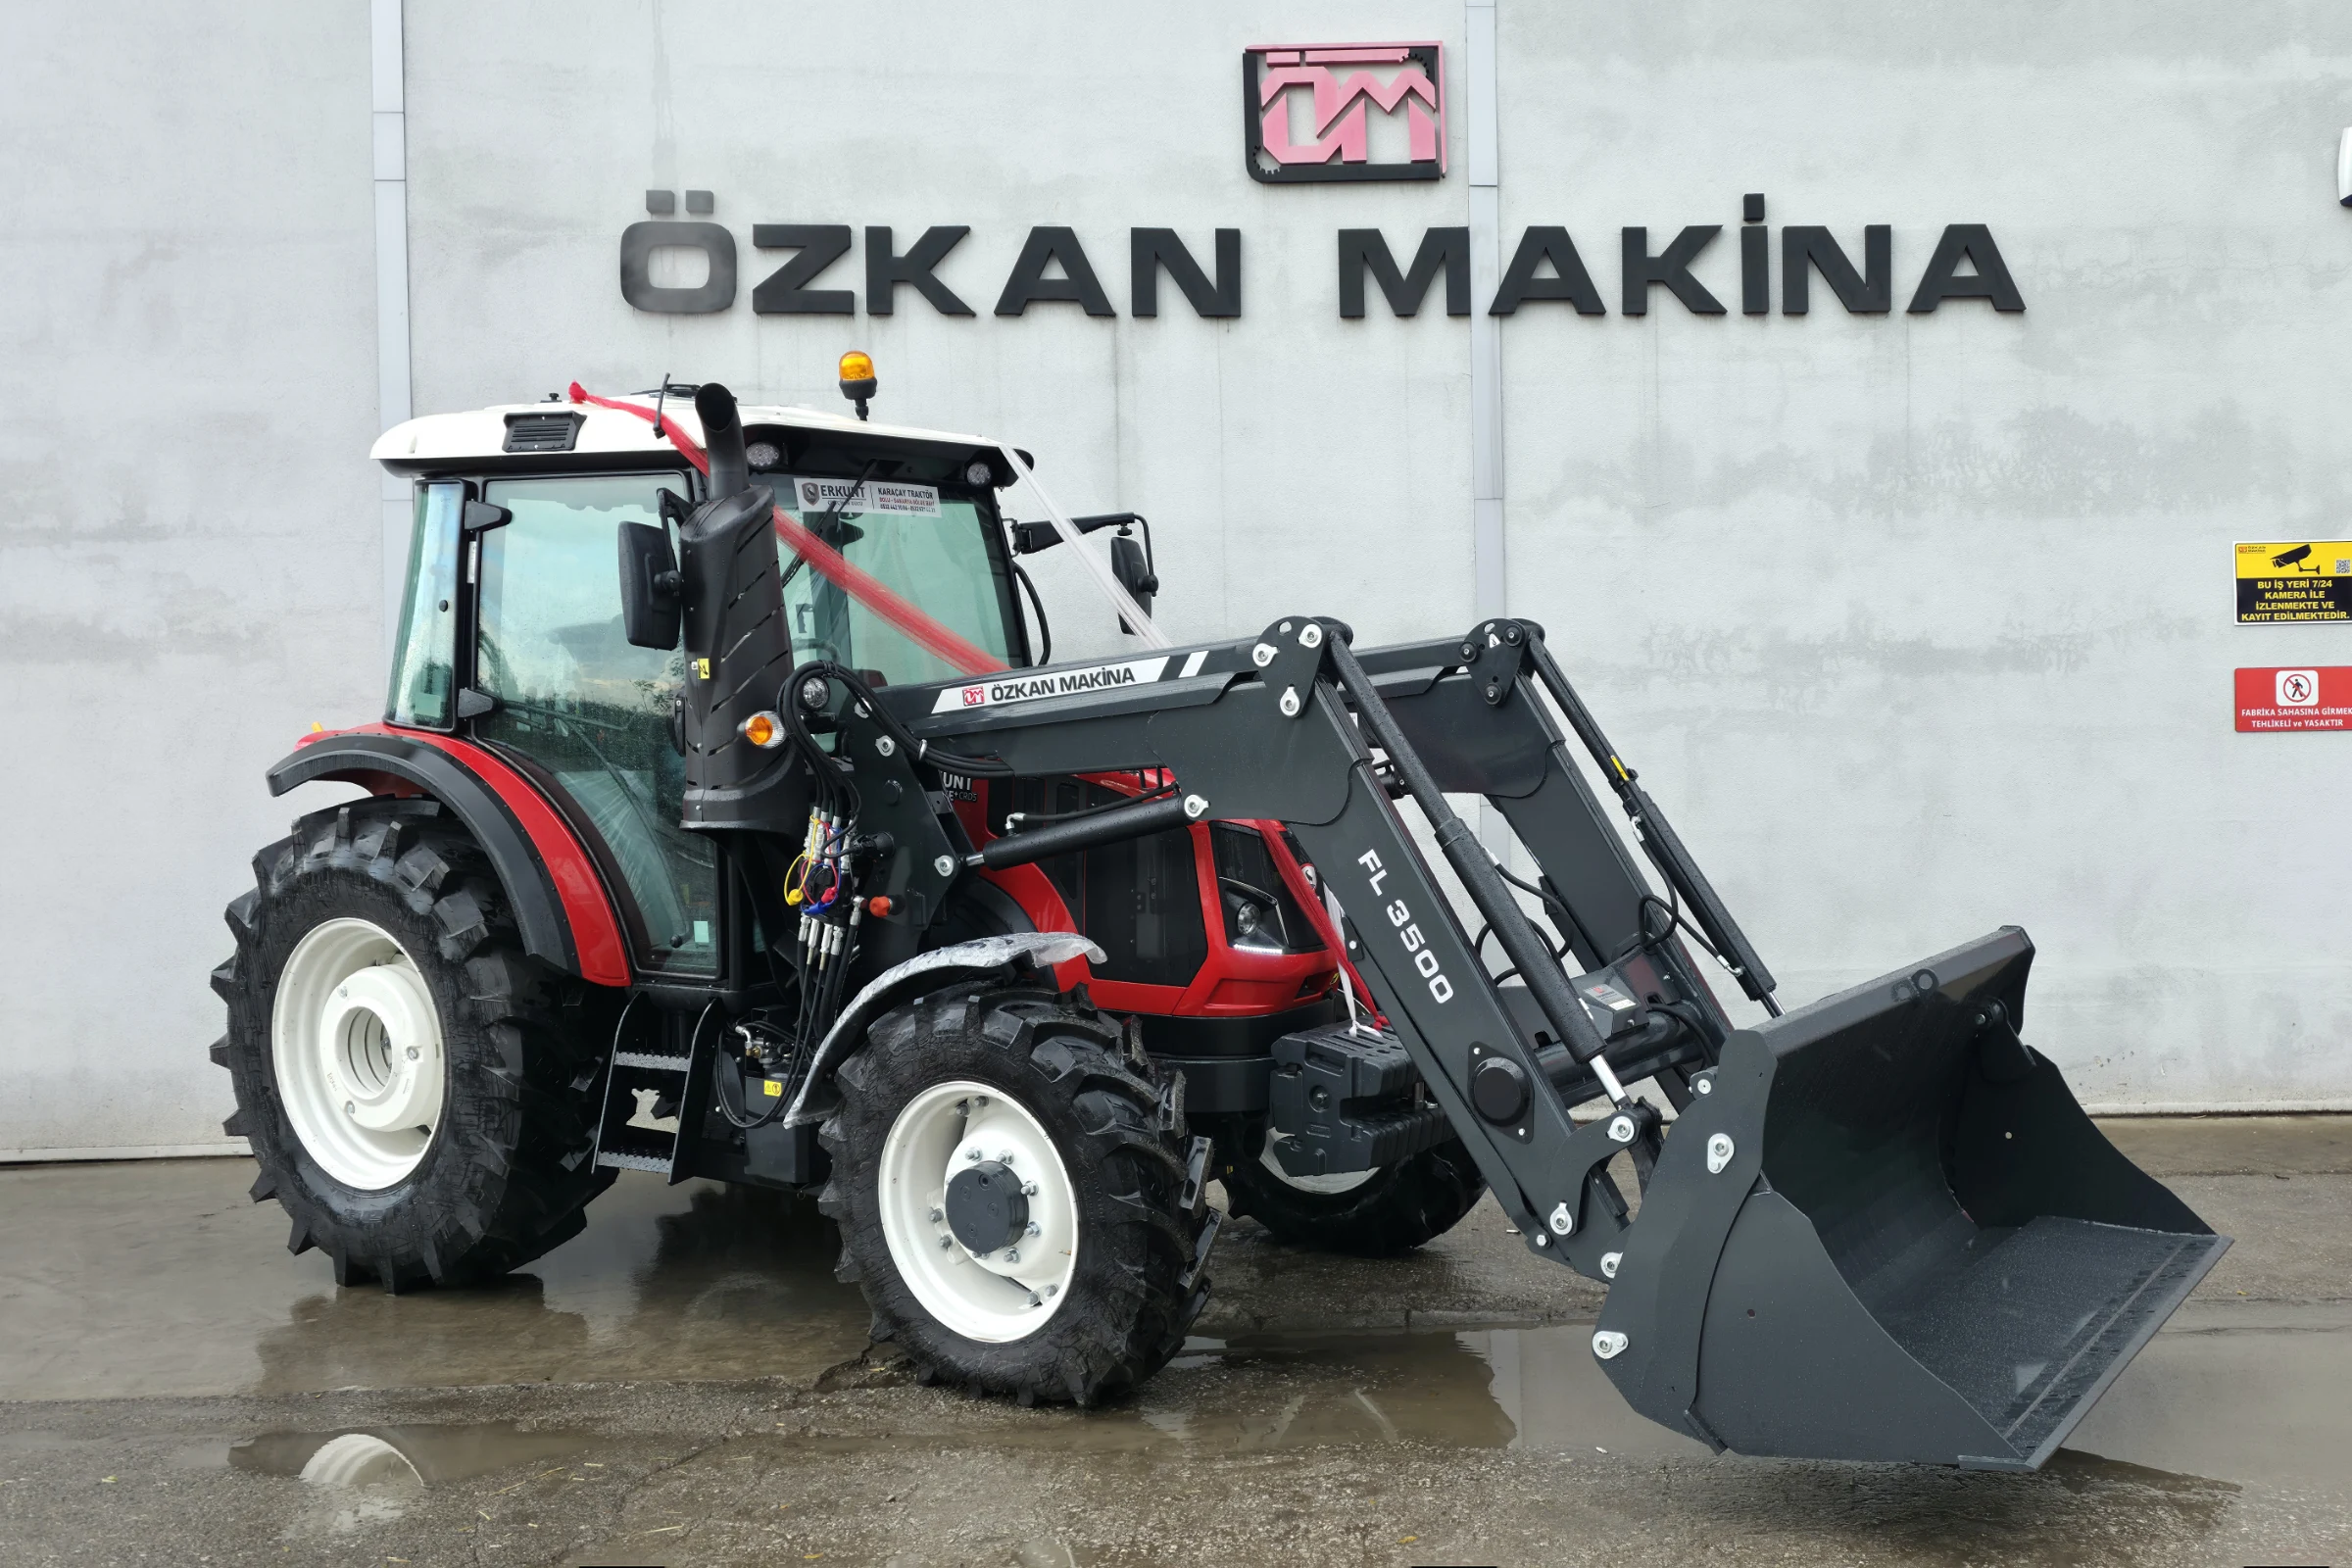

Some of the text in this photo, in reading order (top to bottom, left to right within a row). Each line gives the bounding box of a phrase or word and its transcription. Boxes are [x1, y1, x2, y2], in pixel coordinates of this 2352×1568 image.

[620, 189, 2027, 318] ÖZKAN MAKİNA
[820, 485, 865, 498] ERKUNT
[878, 487, 934, 500] KARAÇAY TRAKTÖR
[2274, 579, 2283, 590] İŞ
[2286, 578, 2310, 588] YERİ
[2312, 579, 2332, 588] 7/24
[2265, 589, 2326, 600] KAMERA İLE
[2255, 601, 2319, 611] İZLENMEKTE
[2241, 610, 2350, 621] KAYIT EDİLMEKTEDİR.
[991, 678, 1055, 702] ÖZKAN
[1059, 666, 1136, 692] MAKİNA
[2241, 706, 2352, 716] FABRİKA SAHASINA GİRMEK
[2251, 718, 2291, 728] TEHLİKELİ
[2304, 718, 2344, 727] YASAKTIR
[1357, 849, 1454, 1004] FL 3500
